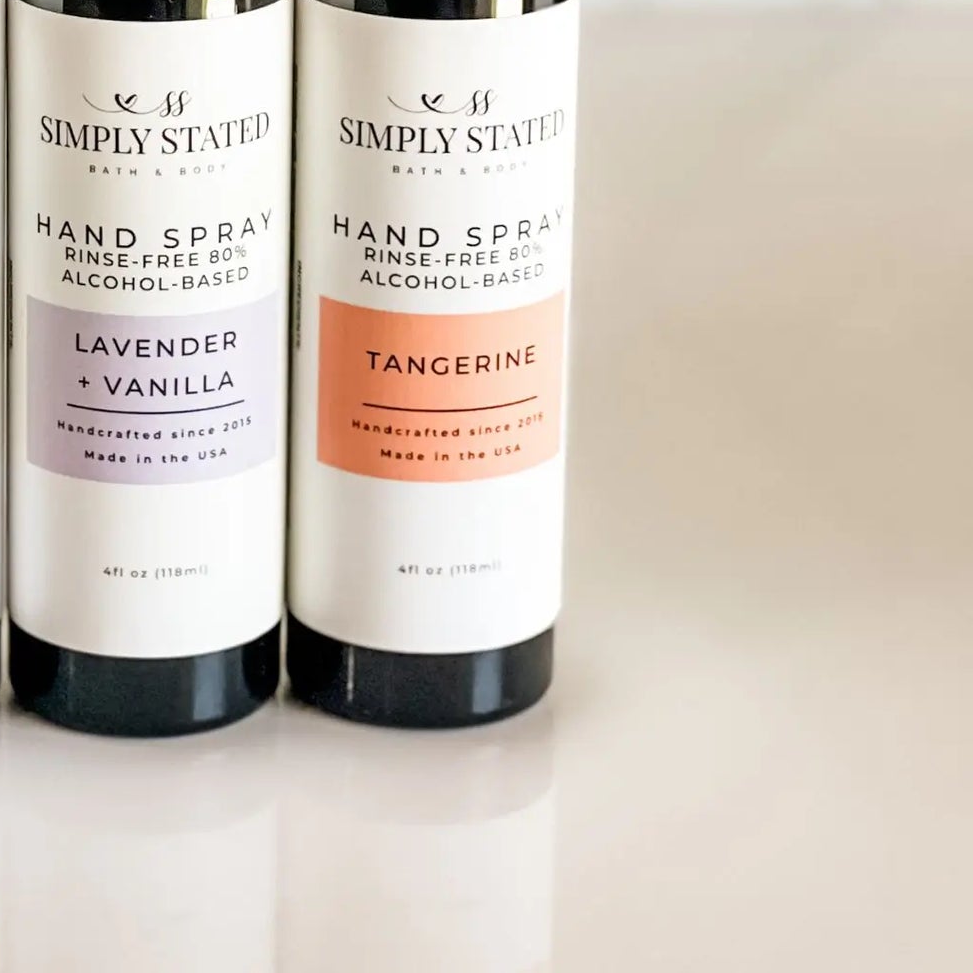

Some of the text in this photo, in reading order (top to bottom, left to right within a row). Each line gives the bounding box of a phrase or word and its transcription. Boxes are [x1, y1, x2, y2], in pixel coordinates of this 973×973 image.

[40, 111, 270, 155] SIMPLY STATED
[339, 108, 565, 154] SIMPLY STATED
[89, 165, 137, 176] BATH
[155, 168, 162, 176] &
[392, 164, 442, 176] BATH
[459, 167, 466, 176] &
[37, 208, 272, 249] HAND SPRAY
[333, 203, 564, 248] HAND SPRAY
[65, 245, 247, 269] RINSE-FREE 80%
[364, 246, 500, 267] RINSE-FREE
[61, 266, 249, 291] ALCOHOL-BASED
[360, 263, 544, 290] ALCOHOL-BASED
[76, 331, 237, 358] LAVENDER
[366, 344, 536, 376] TANGERINE
[78, 371, 234, 397] + VANILLA
[57, 416, 252, 440] Handcrafted since 2015
[352, 418, 460, 438] Handcrafted
[469, 423, 510, 437] since
[85, 448, 227, 464] Made in the USA
[380, 443, 521, 461] Made in the USA
[103, 567, 123, 577] 4fl
[131, 569, 147, 578] oz
